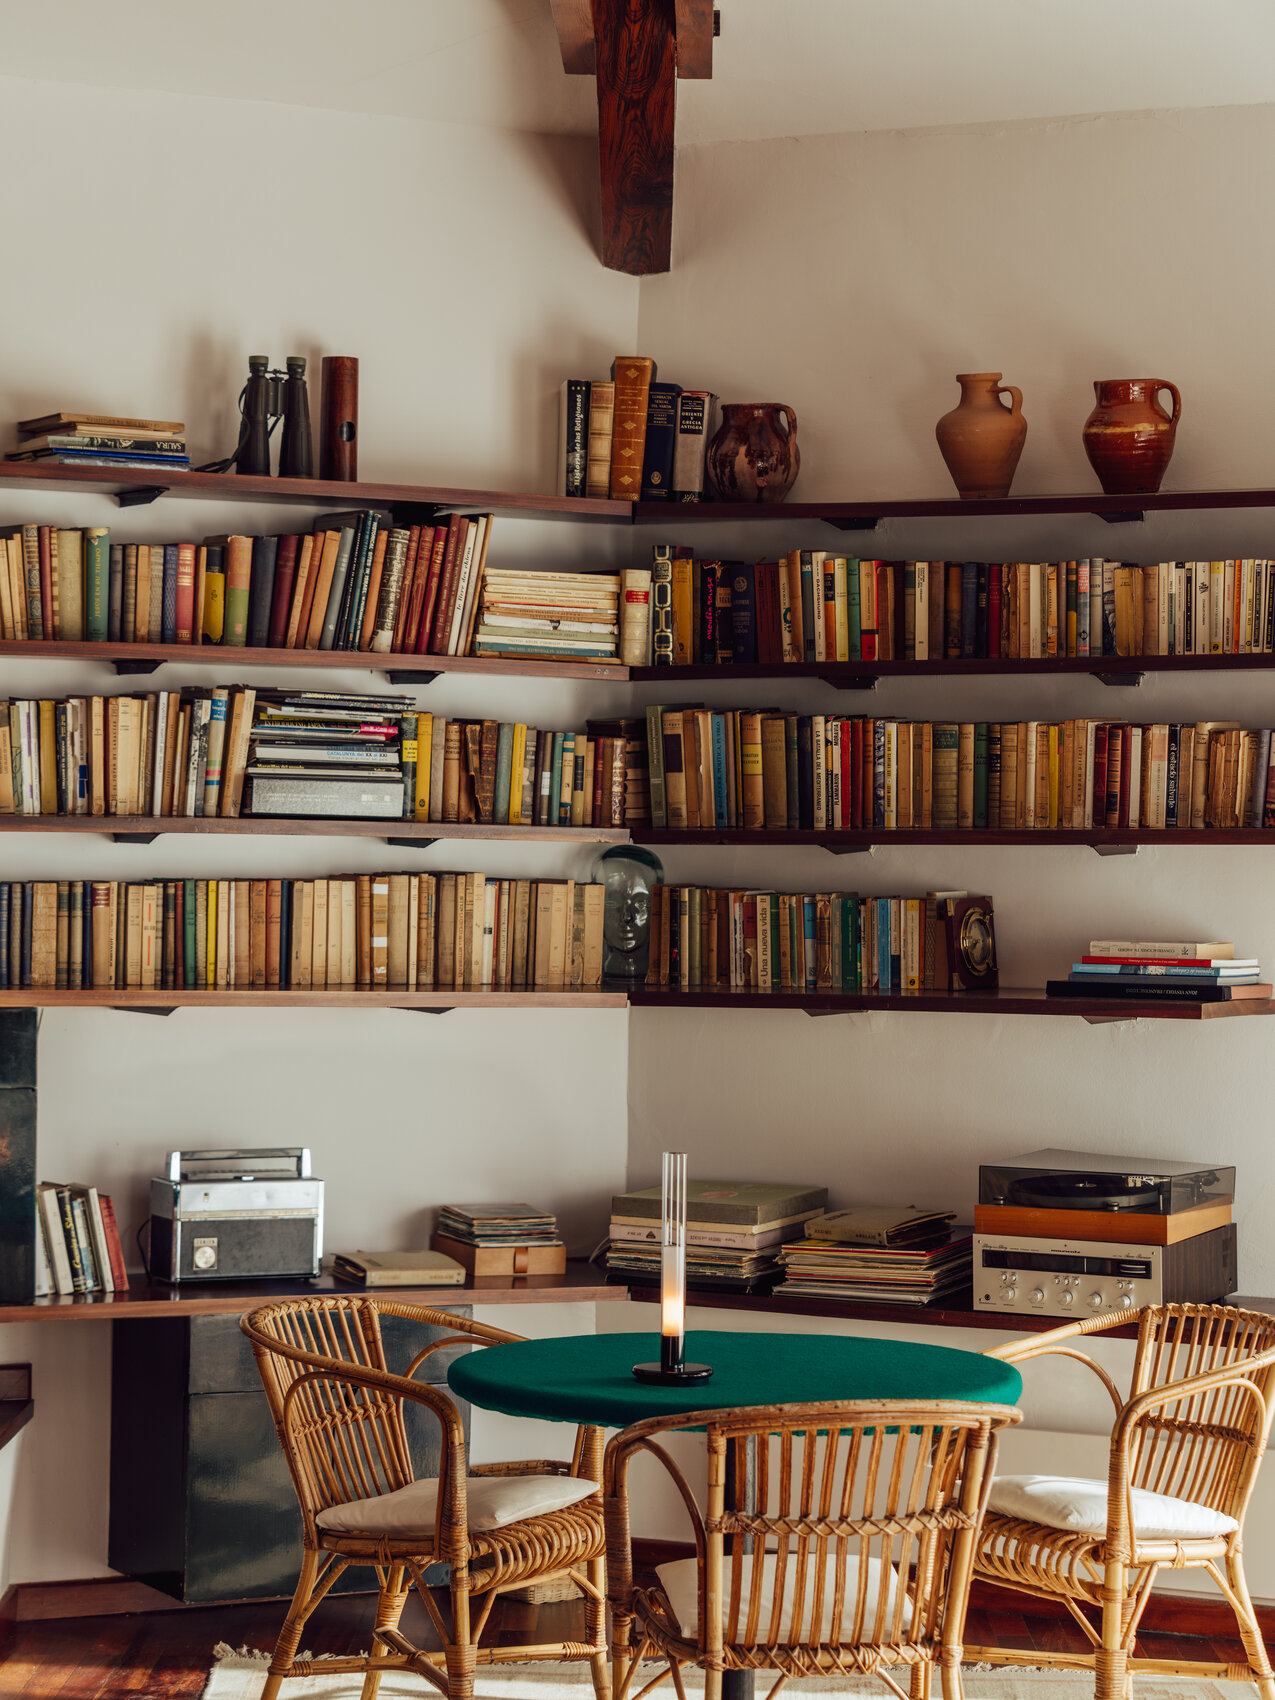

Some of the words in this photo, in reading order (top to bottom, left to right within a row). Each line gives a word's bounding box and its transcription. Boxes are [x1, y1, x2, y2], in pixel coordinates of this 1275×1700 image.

[574, 394, 583, 431] Religiones
[156, 441, 181, 450] SAURA
[573, 453, 581, 485] Historia
[369, 522, 378, 549] HISTORICAL
[706, 577, 714, 605] rouge
[705, 607, 713, 640] moulin
[1167, 780, 1175, 808] salvaje
